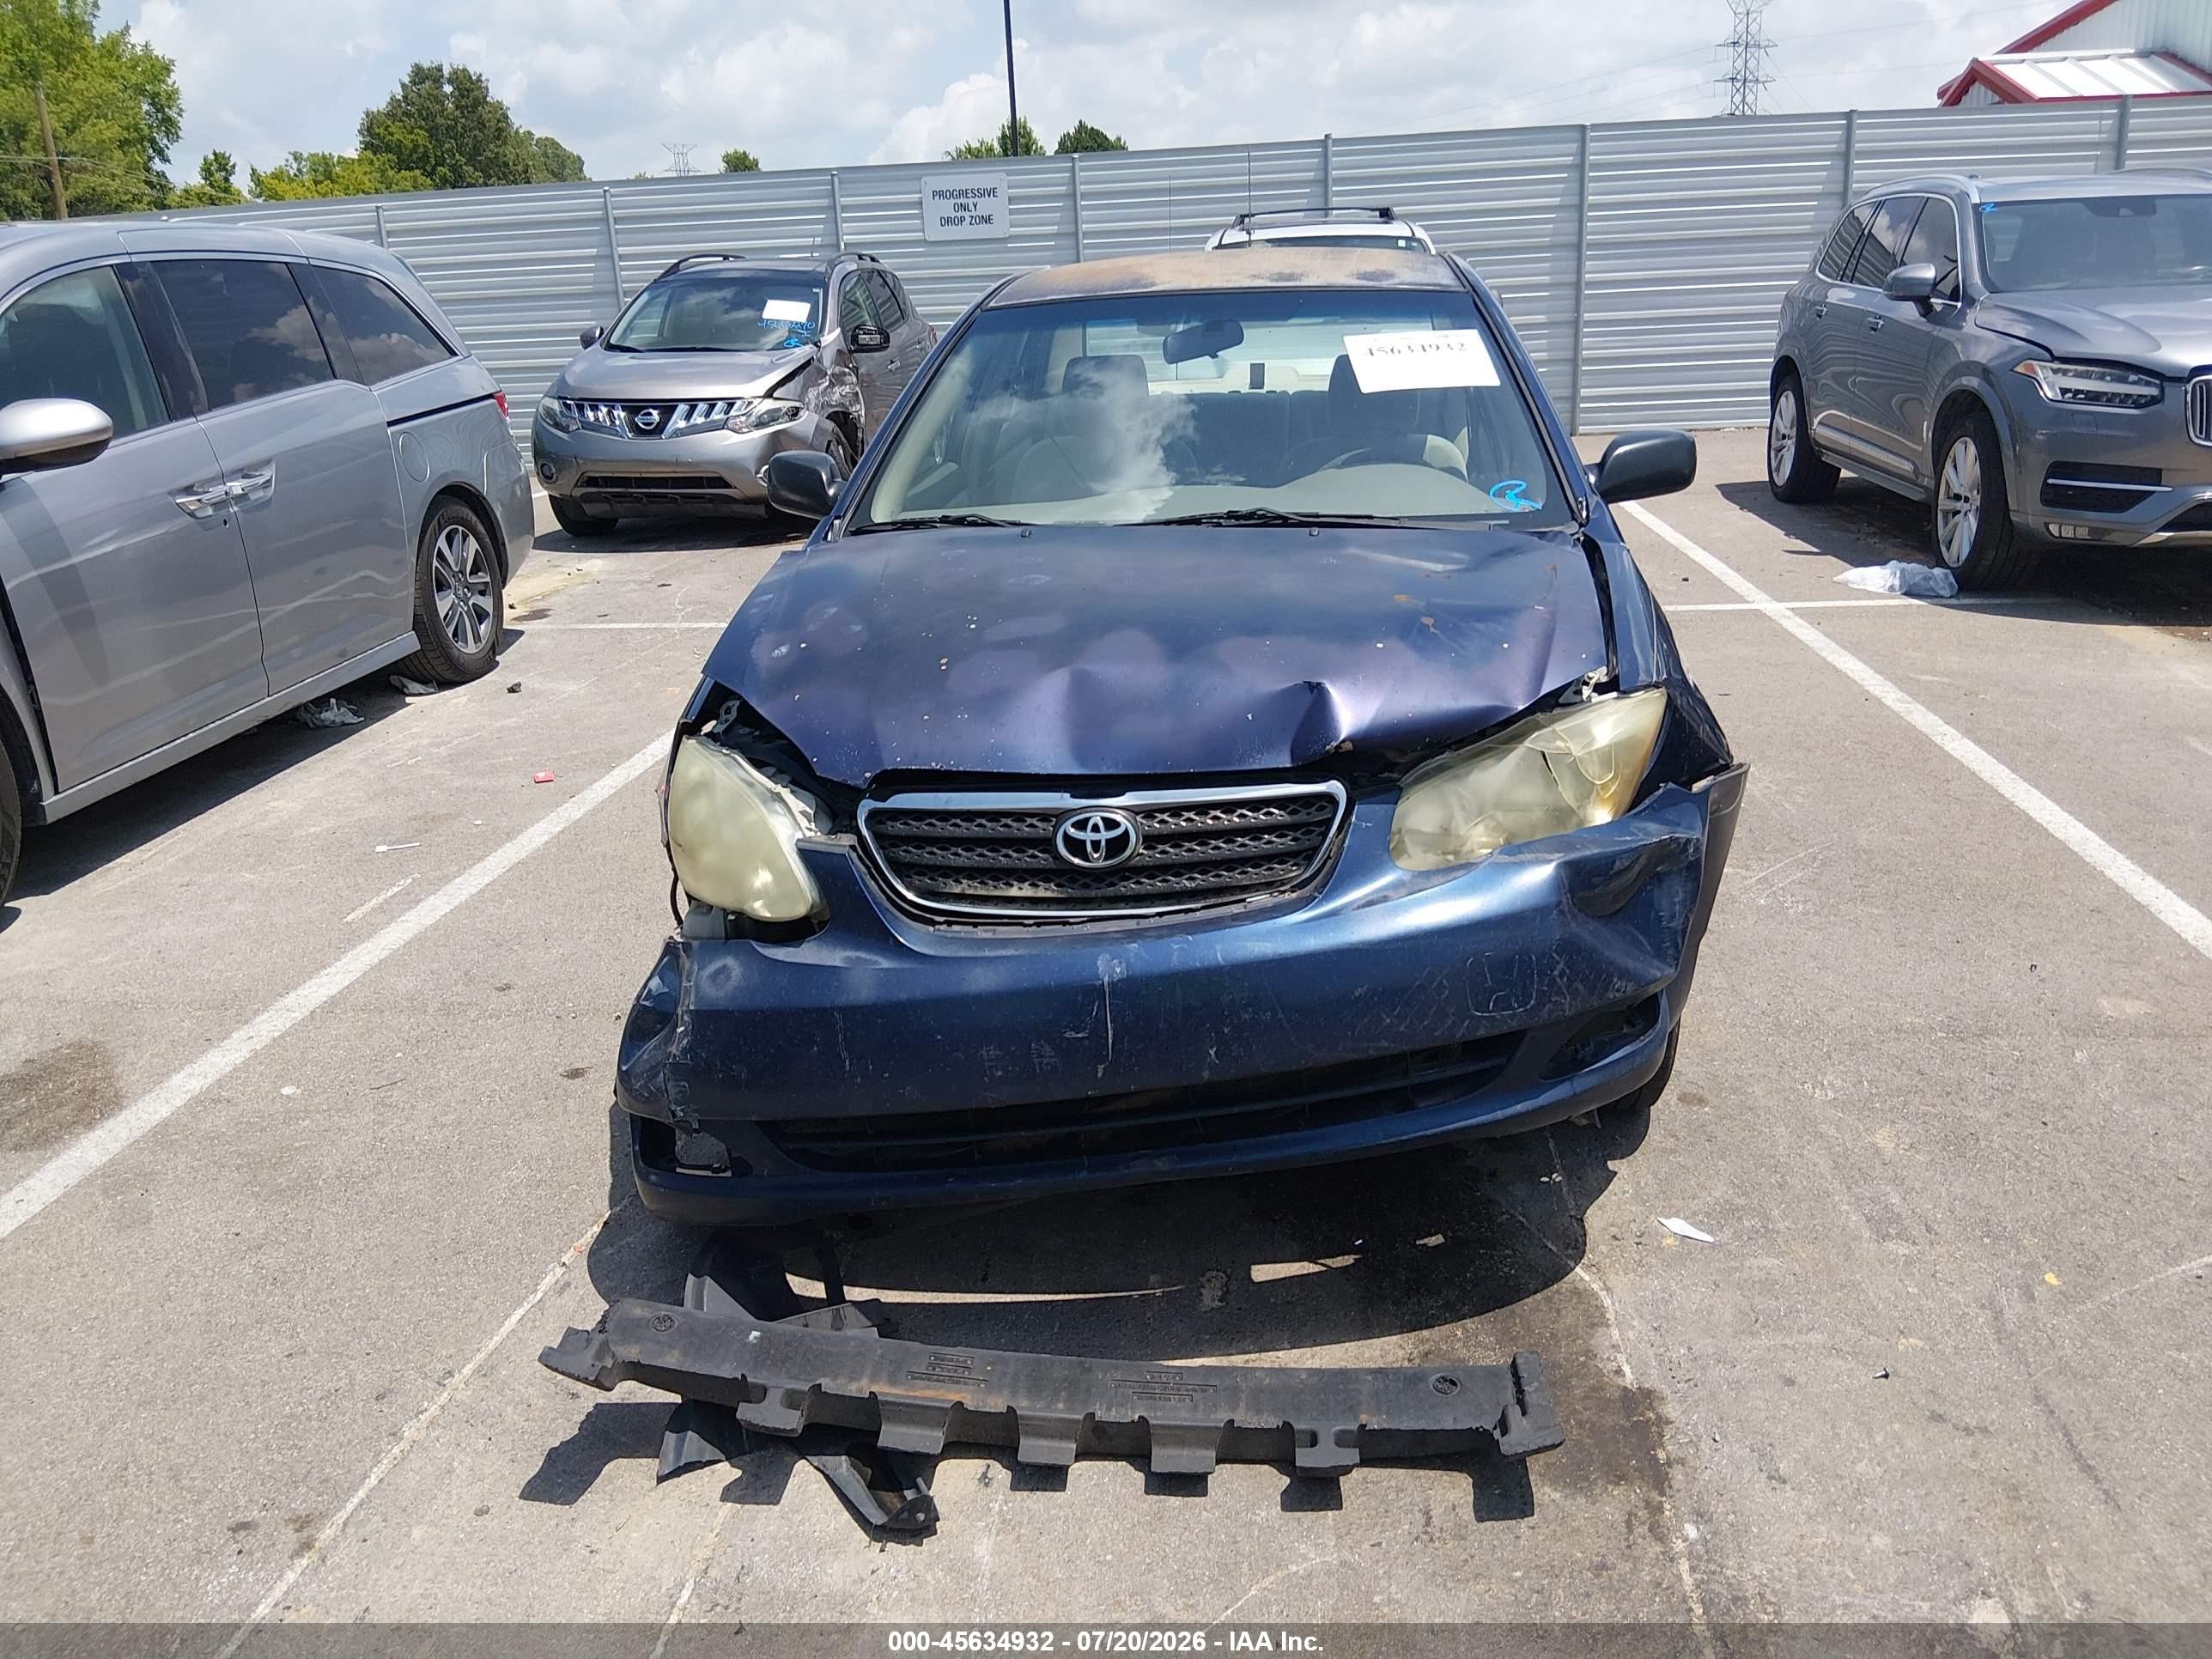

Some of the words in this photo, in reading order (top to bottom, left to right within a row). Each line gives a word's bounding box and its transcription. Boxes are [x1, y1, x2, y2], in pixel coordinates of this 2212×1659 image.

[932, 187, 998, 200] PROGRESSIVE
[953, 201, 978, 213] ONLY
[939, 216, 966, 227] DROP
[969, 214, 994, 226] ZONE
